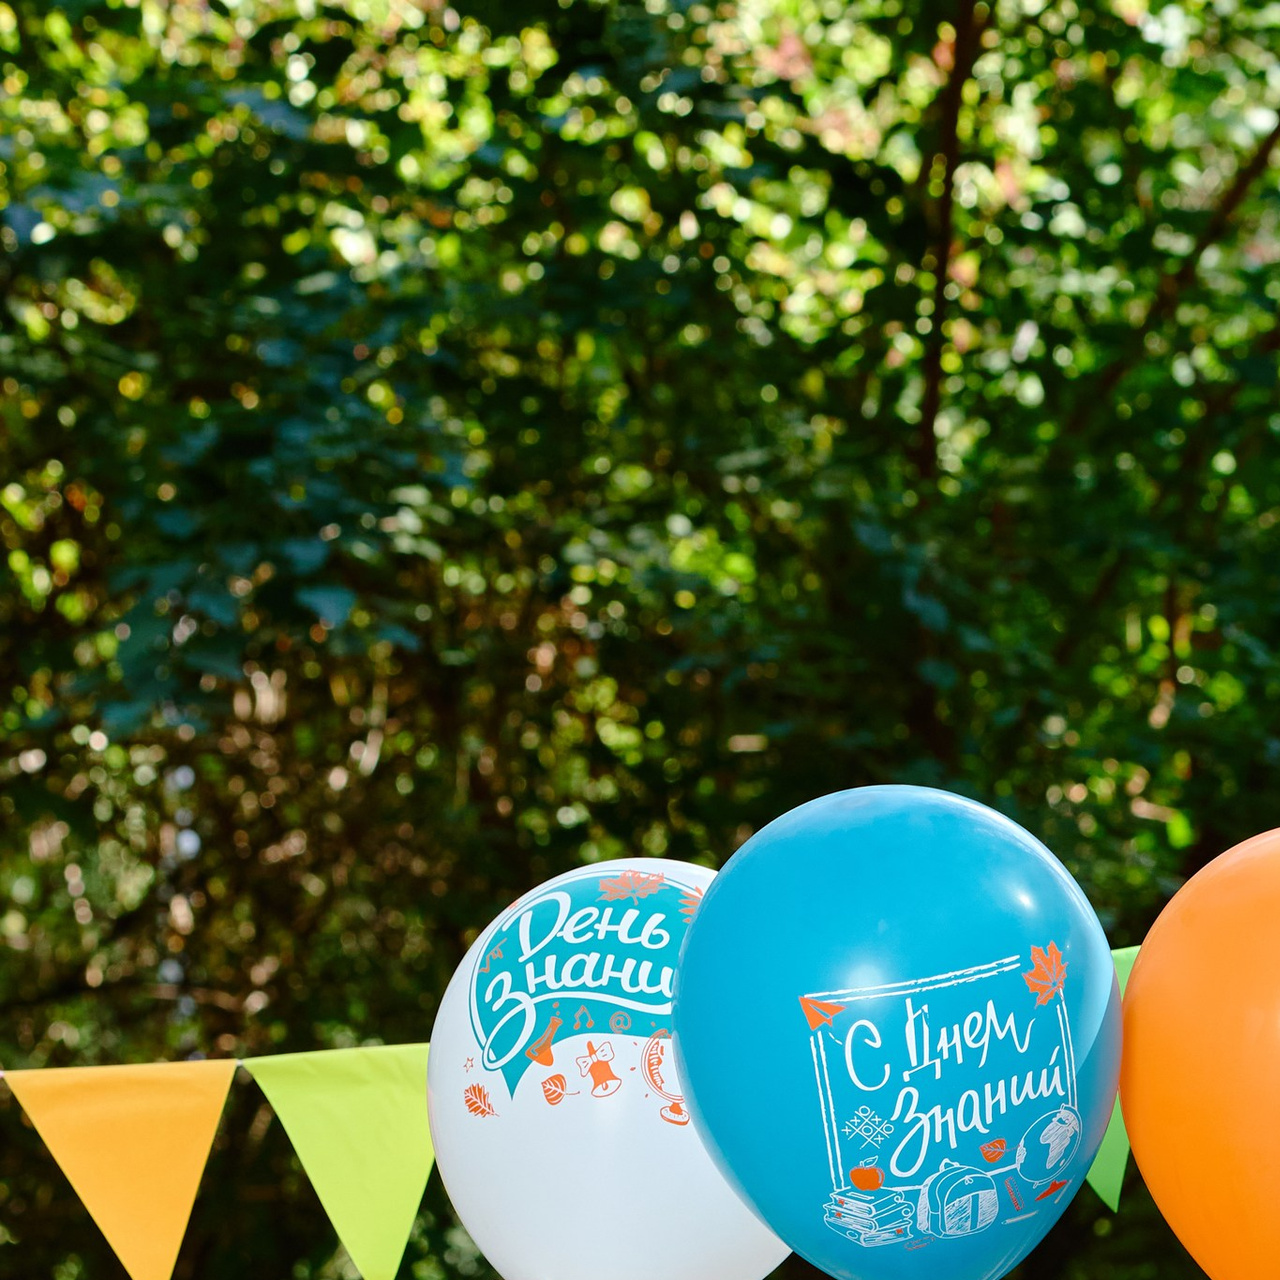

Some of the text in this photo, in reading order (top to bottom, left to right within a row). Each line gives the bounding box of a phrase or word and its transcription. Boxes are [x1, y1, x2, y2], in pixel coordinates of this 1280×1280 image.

[502, 891, 670, 963] День
[482, 952, 674, 1072] Знани
[844, 997, 1036, 1092] С Днем
[889, 1045, 1066, 1178] Знаний
